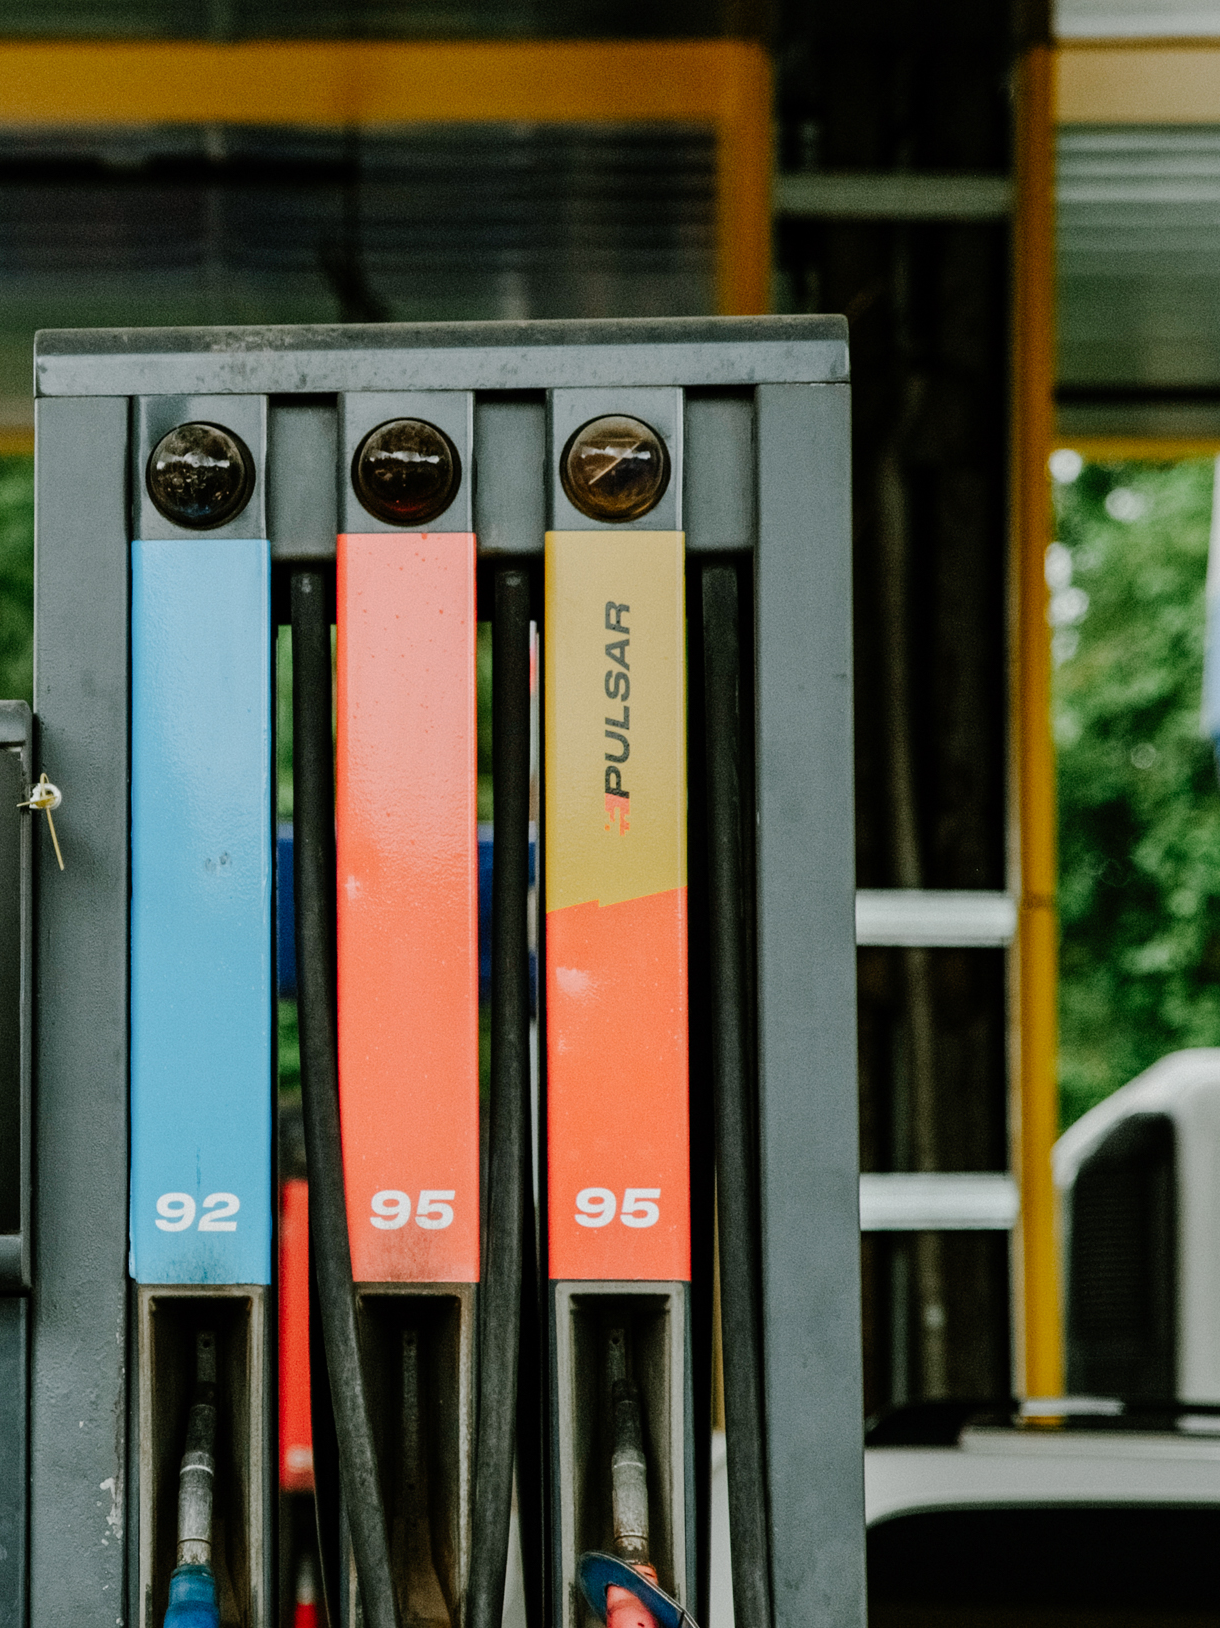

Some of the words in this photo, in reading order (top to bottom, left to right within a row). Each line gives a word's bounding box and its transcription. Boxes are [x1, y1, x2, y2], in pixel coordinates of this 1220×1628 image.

[603, 600, 631, 800] PULSAR
[154, 1192, 241, 1233] 92
[369, 1189, 456, 1231] 95
[574, 1186, 662, 1229] 95
